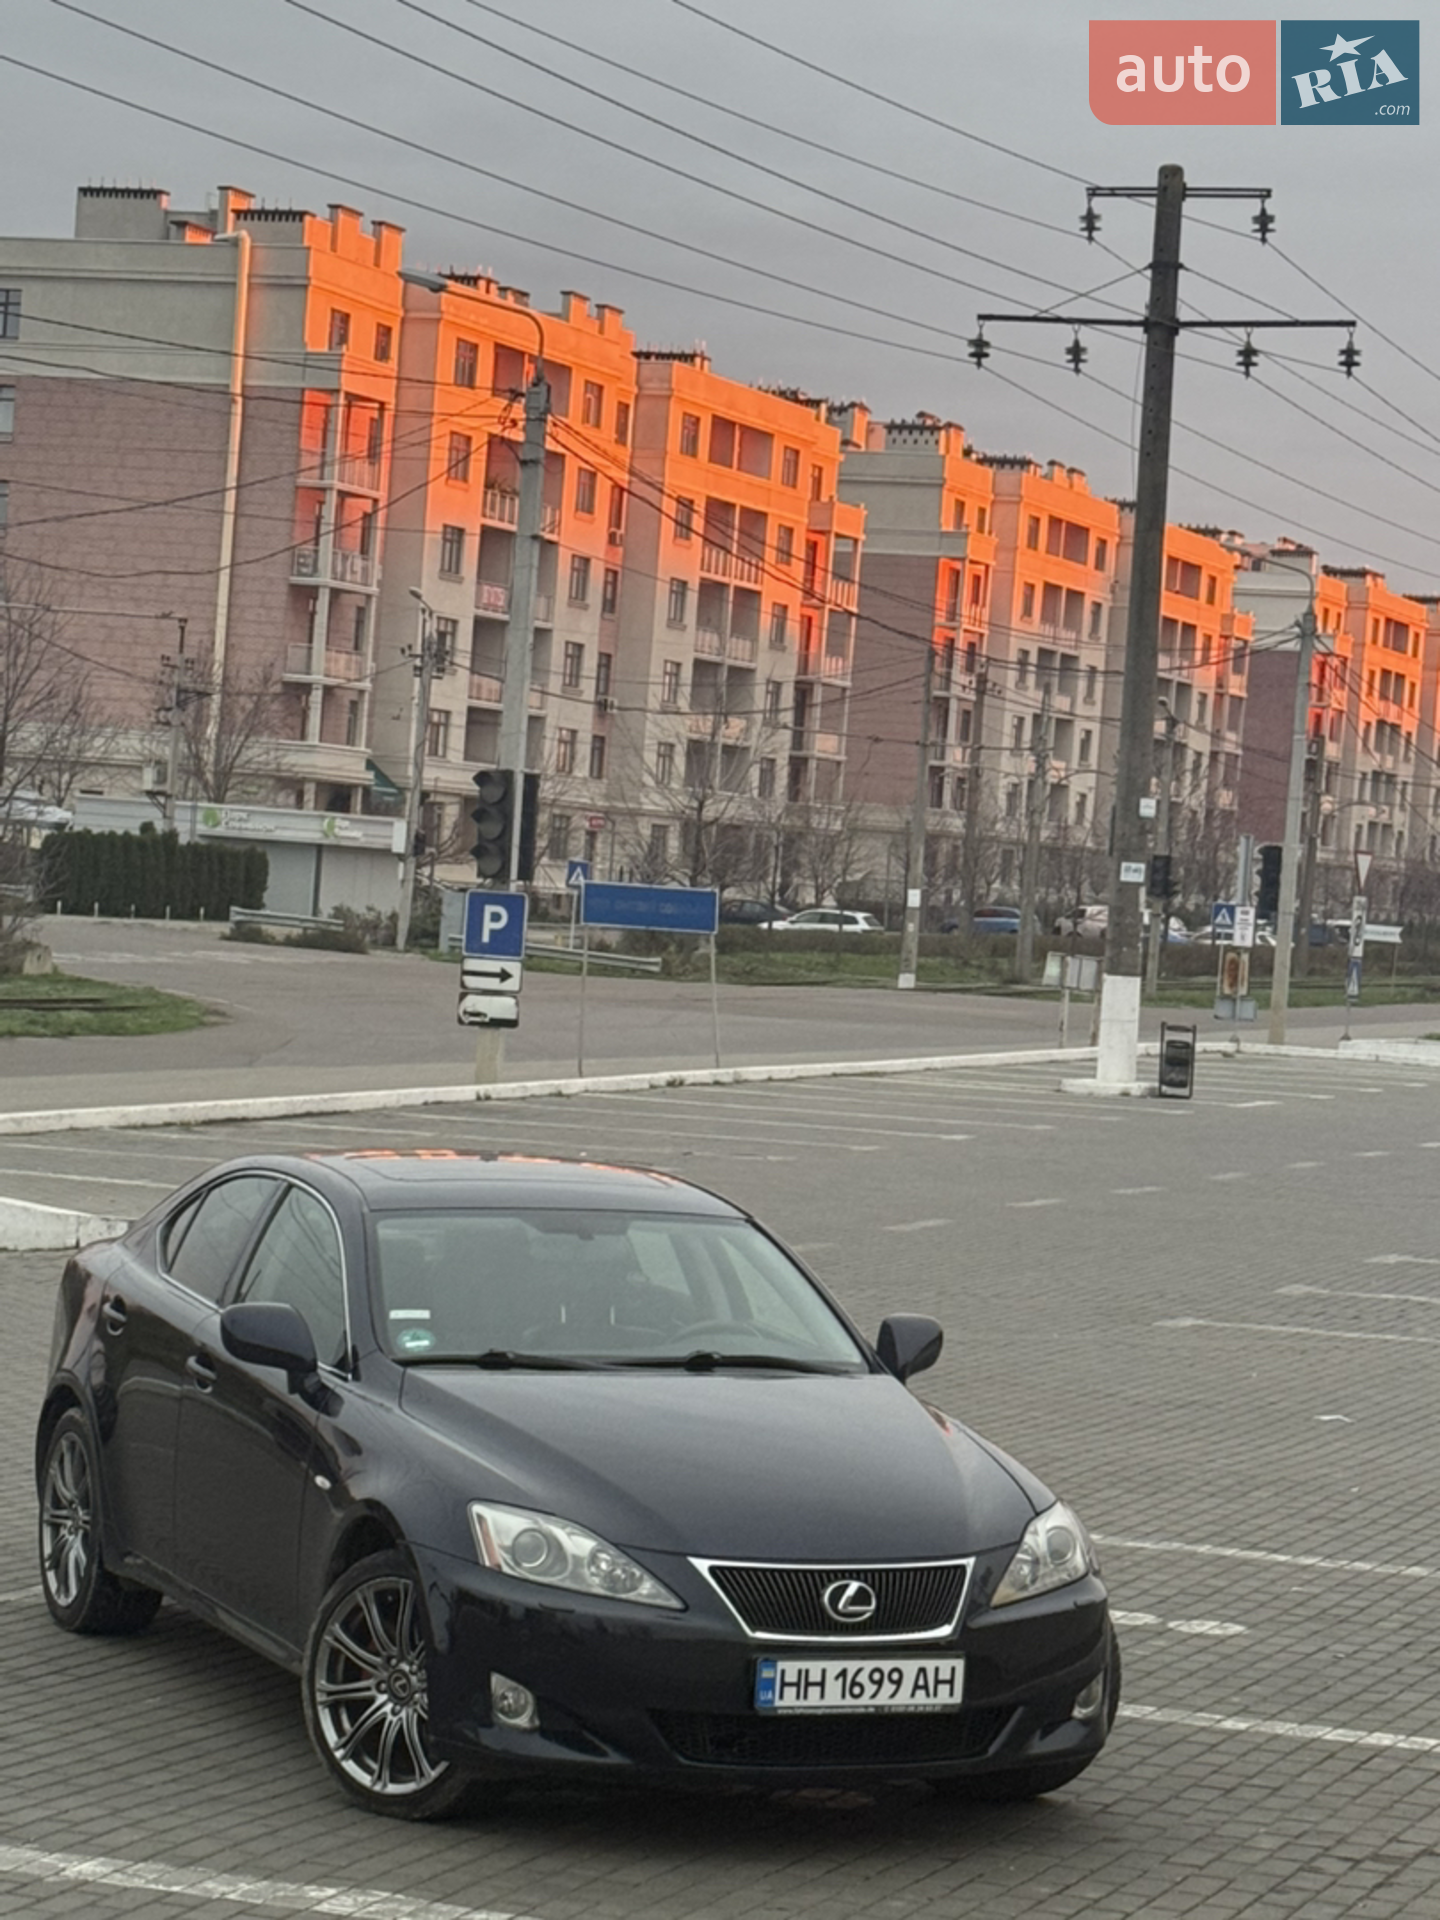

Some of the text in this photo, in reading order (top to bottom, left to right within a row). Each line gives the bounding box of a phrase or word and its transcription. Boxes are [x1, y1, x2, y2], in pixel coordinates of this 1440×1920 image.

[481, 904, 509, 944] P
[778, 1666, 956, 1701] HH 1699 AH
